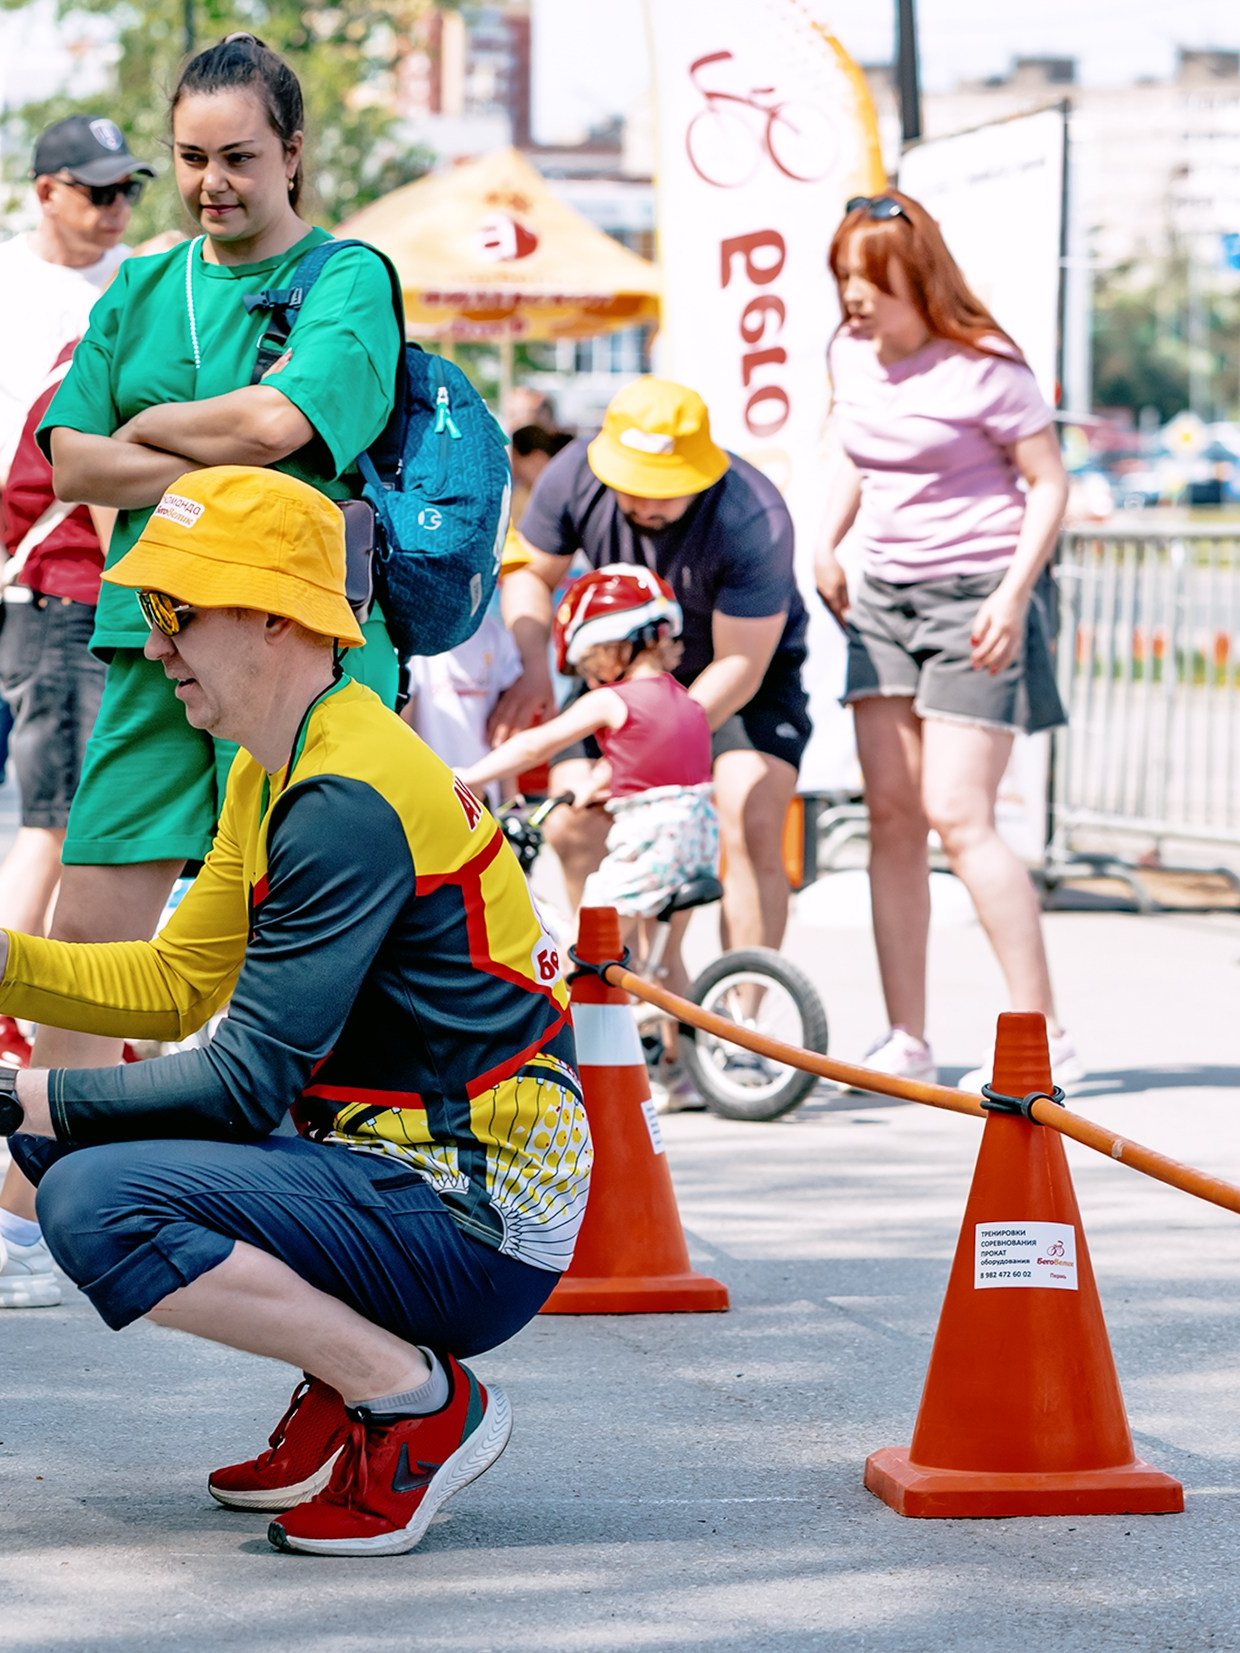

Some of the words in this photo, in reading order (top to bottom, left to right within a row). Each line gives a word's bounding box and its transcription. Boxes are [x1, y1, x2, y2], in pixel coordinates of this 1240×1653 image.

[981, 1229, 1027, 1238] ТРЕНИРОВКИ
[980, 1239, 1038, 1248] СОРЕВНОВАНИЯ
[981, 1249, 1007, 1257] ПРОКАТ
[980, 1258, 1031, 1266] оборудования
[985, 1271, 998, 1279] 982
[998, 1270, 1011, 1278] 472
[1012, 1270, 1022, 1278] 60
[1022, 1270, 1032, 1278] 02
